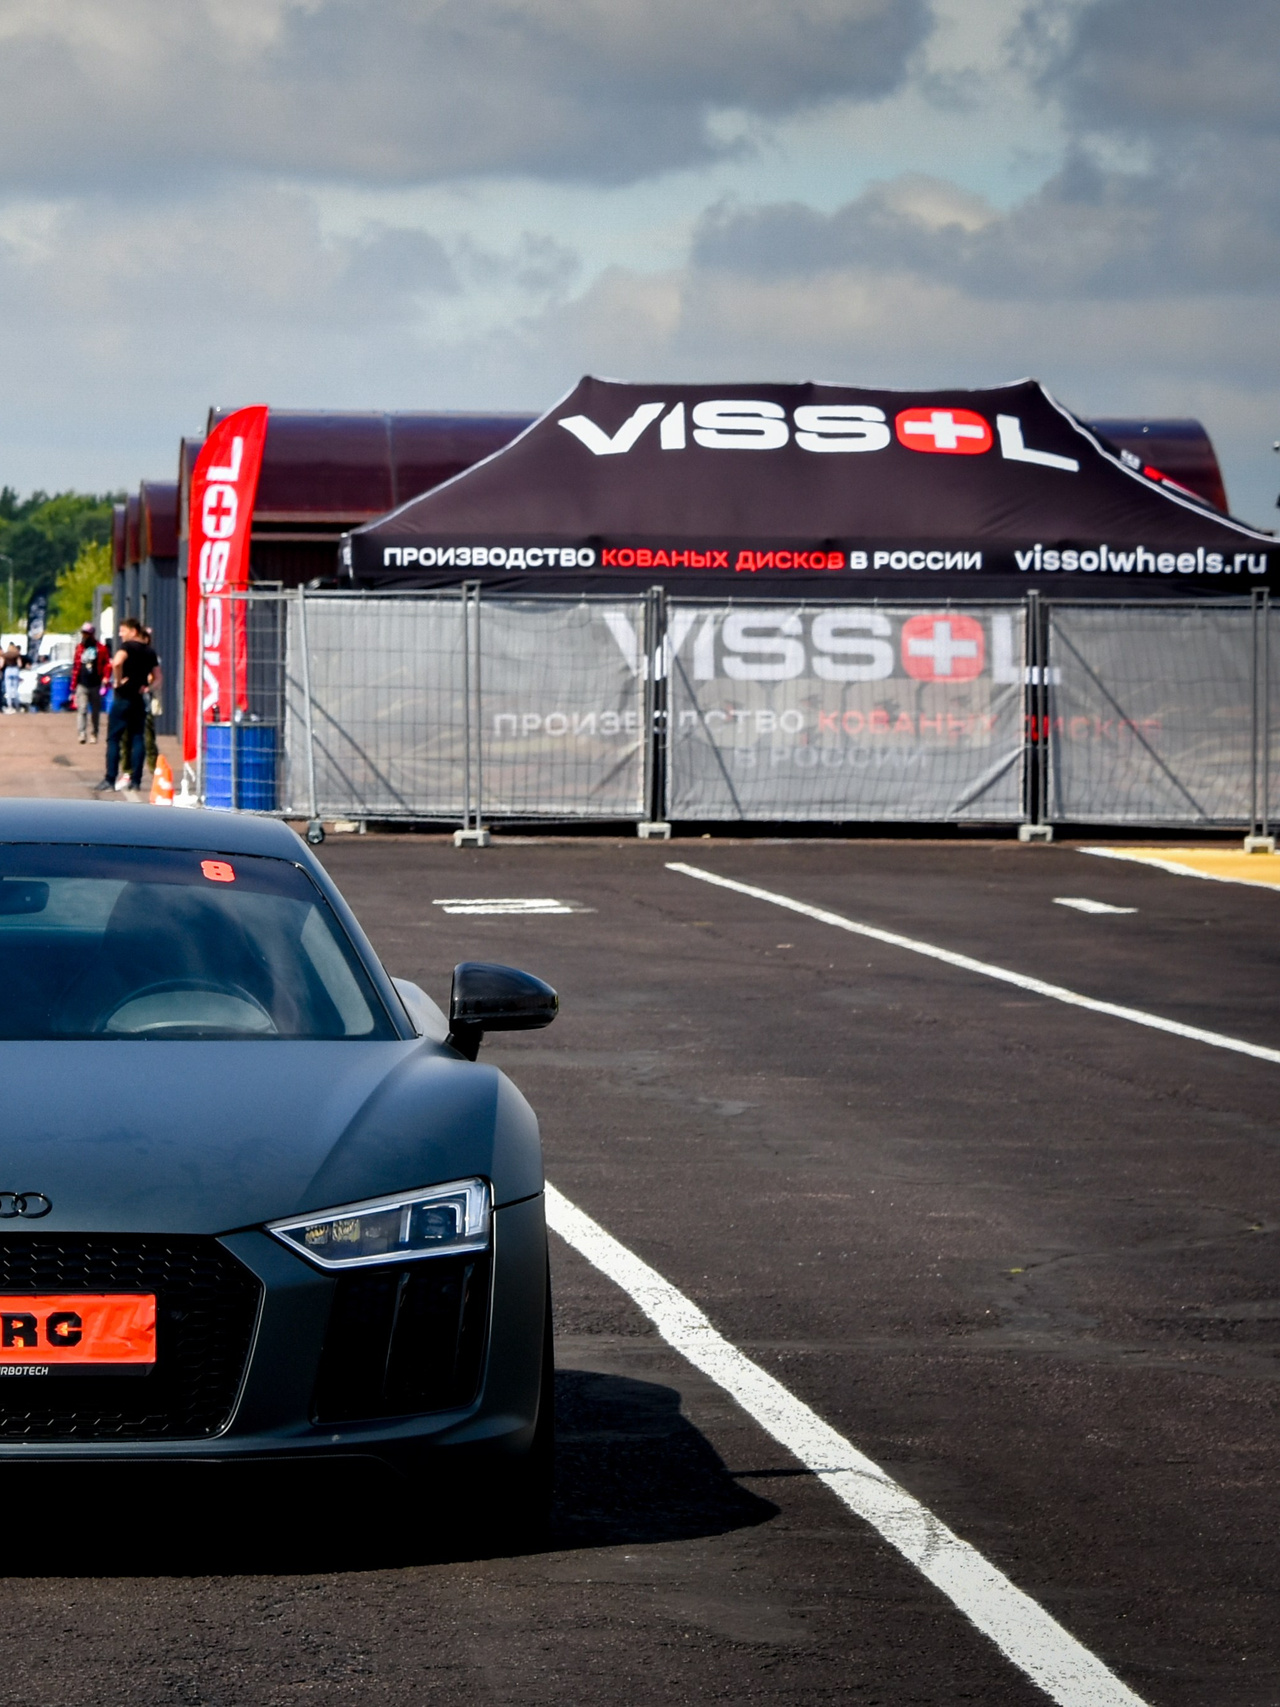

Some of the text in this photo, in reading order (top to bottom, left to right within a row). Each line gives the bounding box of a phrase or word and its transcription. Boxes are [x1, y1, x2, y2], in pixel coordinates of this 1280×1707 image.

[557, 399, 1080, 473] VISSOL
[199, 435, 245, 713] VISSOL
[383, 547, 982, 572] ПРОИЗВОДСТВО КОВАНЫХ ДИСКОВ В РОССИИ
[1014, 543, 1267, 574] vissolwheels.ru
[200, 860, 236, 883] 8
